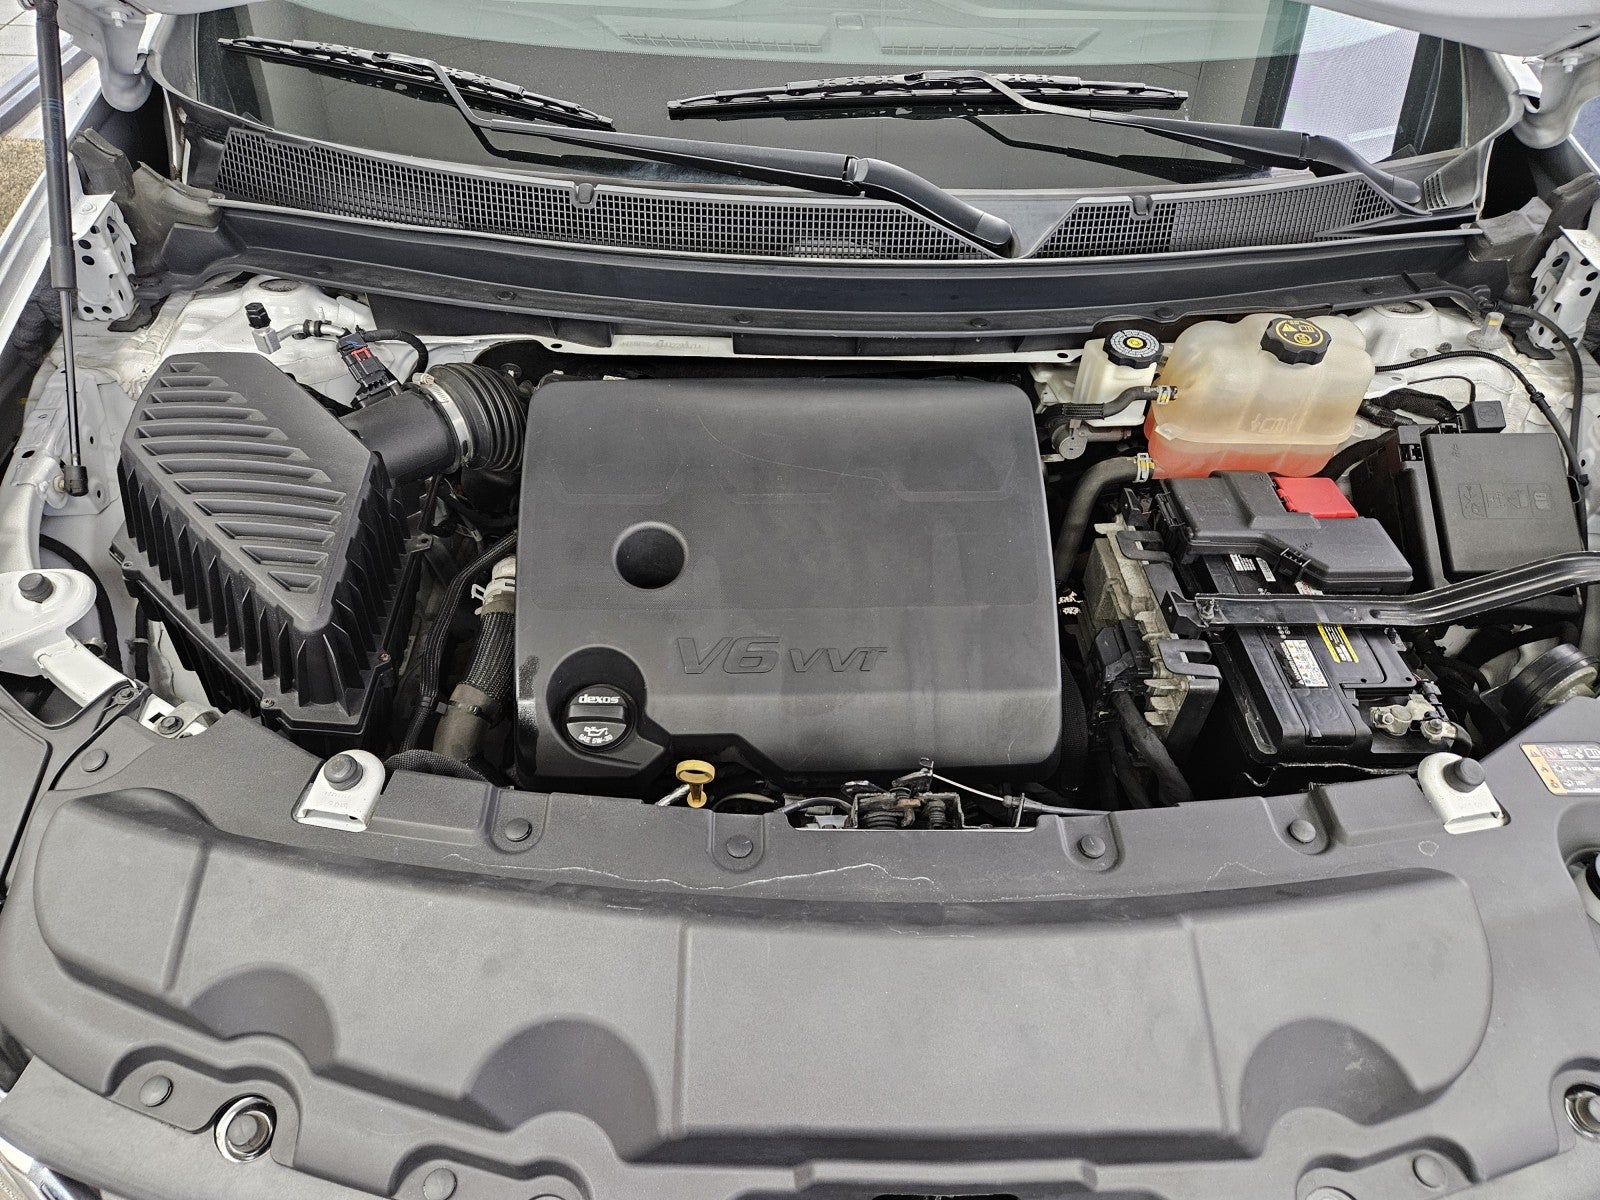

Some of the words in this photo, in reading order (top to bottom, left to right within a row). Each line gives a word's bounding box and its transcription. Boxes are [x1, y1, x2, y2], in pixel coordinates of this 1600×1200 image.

[676, 636, 780, 675] V6
[788, 646, 889, 673] VVT
[578, 693, 621, 704] dexos
